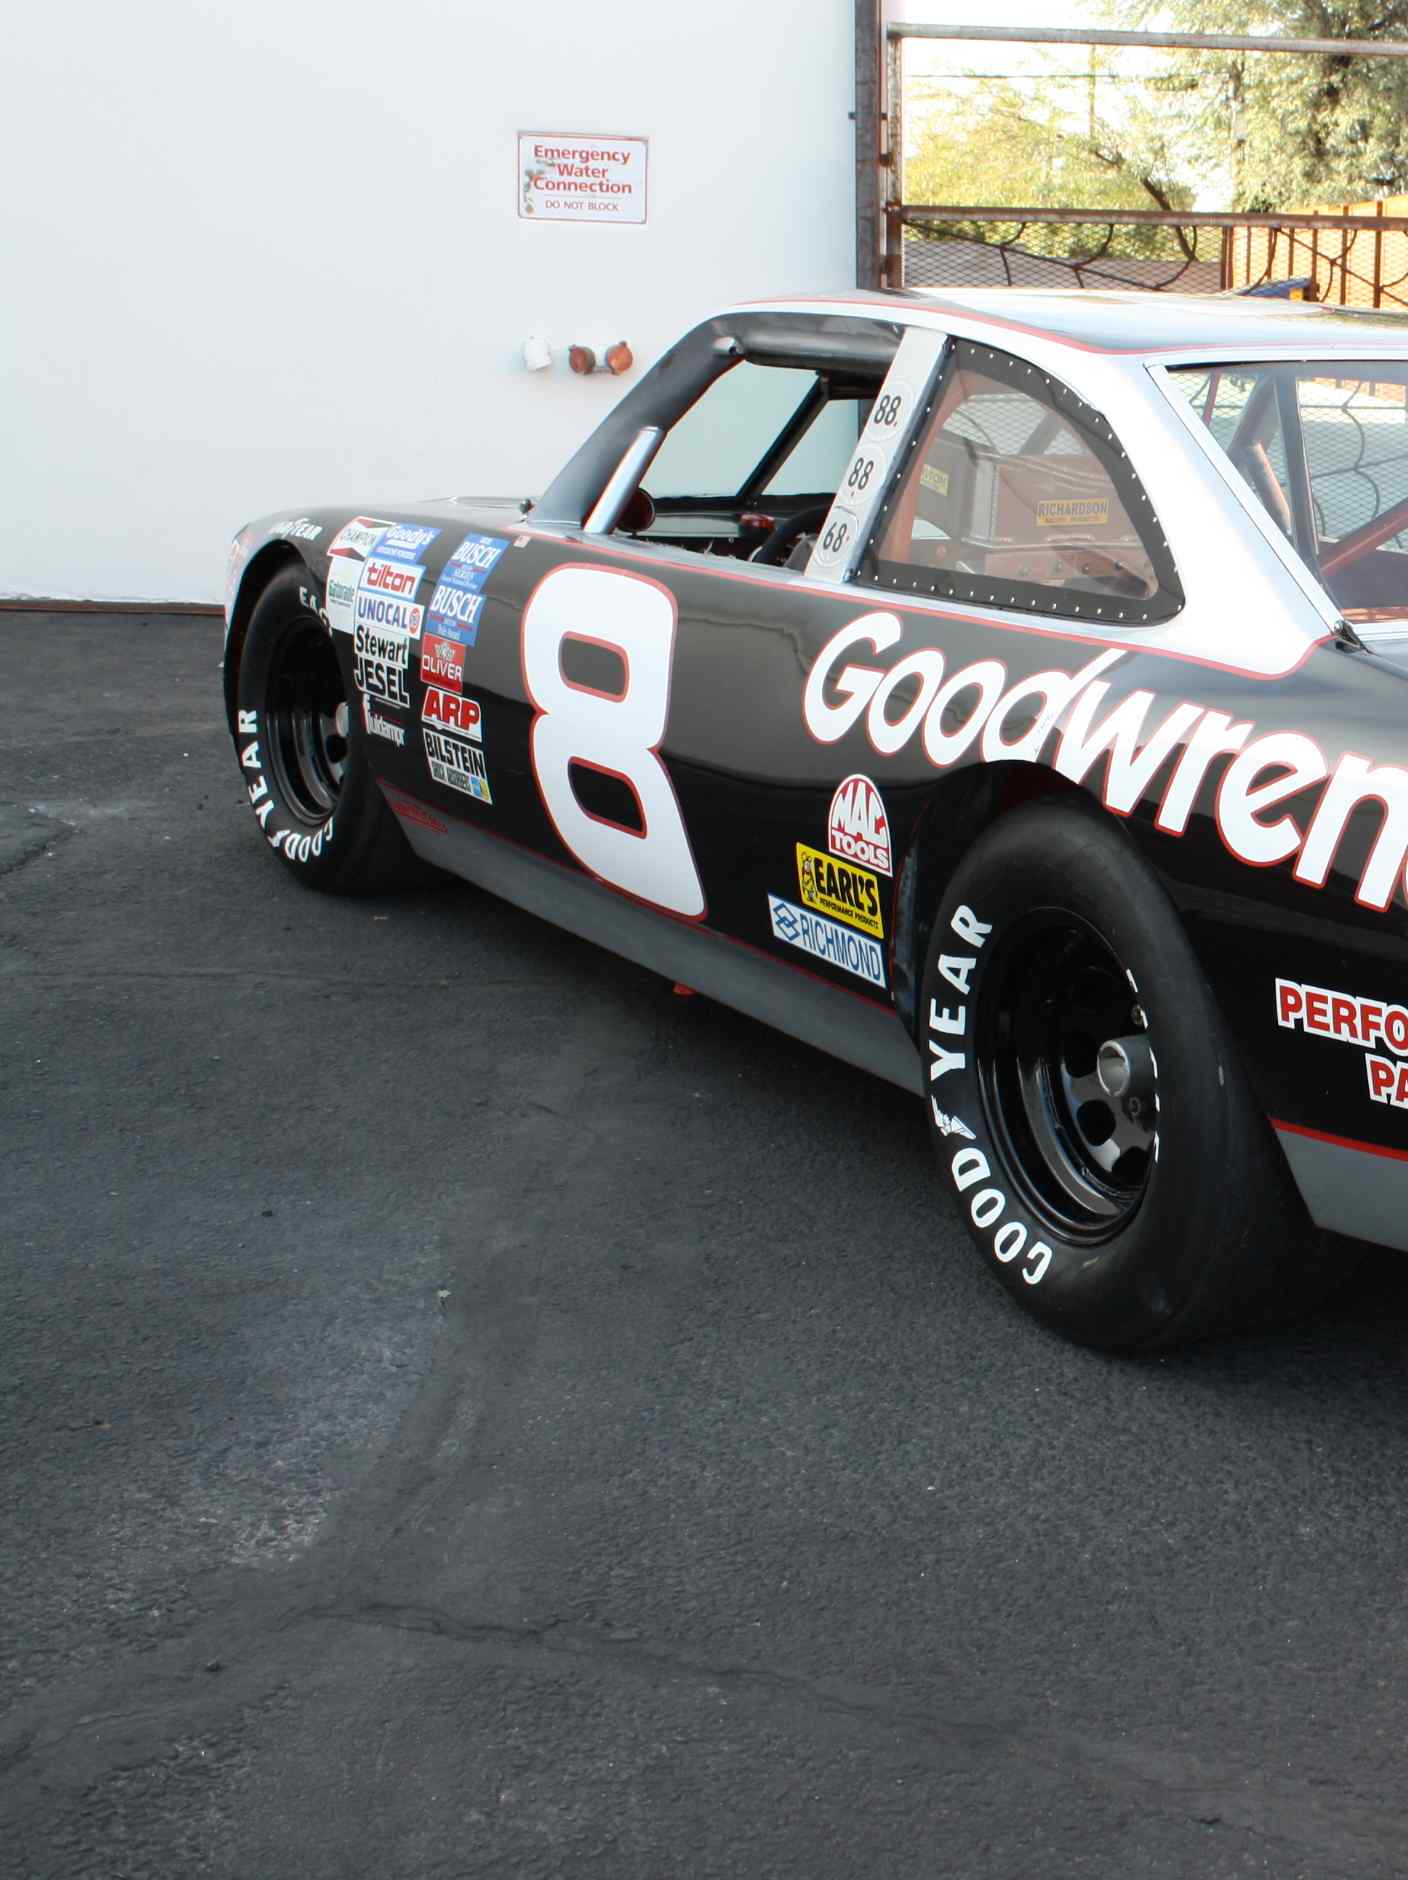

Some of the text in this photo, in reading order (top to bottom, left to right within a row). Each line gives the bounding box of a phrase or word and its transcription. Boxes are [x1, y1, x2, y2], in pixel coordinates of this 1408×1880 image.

[533, 144, 631, 165] Emergency
[556, 163, 609, 179] Water
[532, 175, 633, 194] Connection
[545, 199, 619, 212] DO NOT BLOCK
[1038, 498, 1108, 516] RICHARDSON
[450, 541, 501, 569] BUSCH
[367, 562, 416, 597] tilton
[357, 597, 408, 630] UNOCAL
[430, 585, 483, 623] BUSCH
[355, 624, 408, 665] Stewart
[354, 655, 410, 708] JESEL
[422, 655, 463, 683] OLIVER
[424, 688, 481, 731] ARP
[423, 730, 486, 779] BILSTEIN
[520, 562, 706, 918] 8
[237, 708, 275, 828] YEAR
[831, 780, 888, 849] MAC
[831, 829, 889, 869] TOOLS
[812, 855, 880, 917] EARL'S
[800, 914, 882, 982] RICHMOND
[928, 904, 993, 1082] YEAR
[951, 1146, 1053, 1286] GOOD
